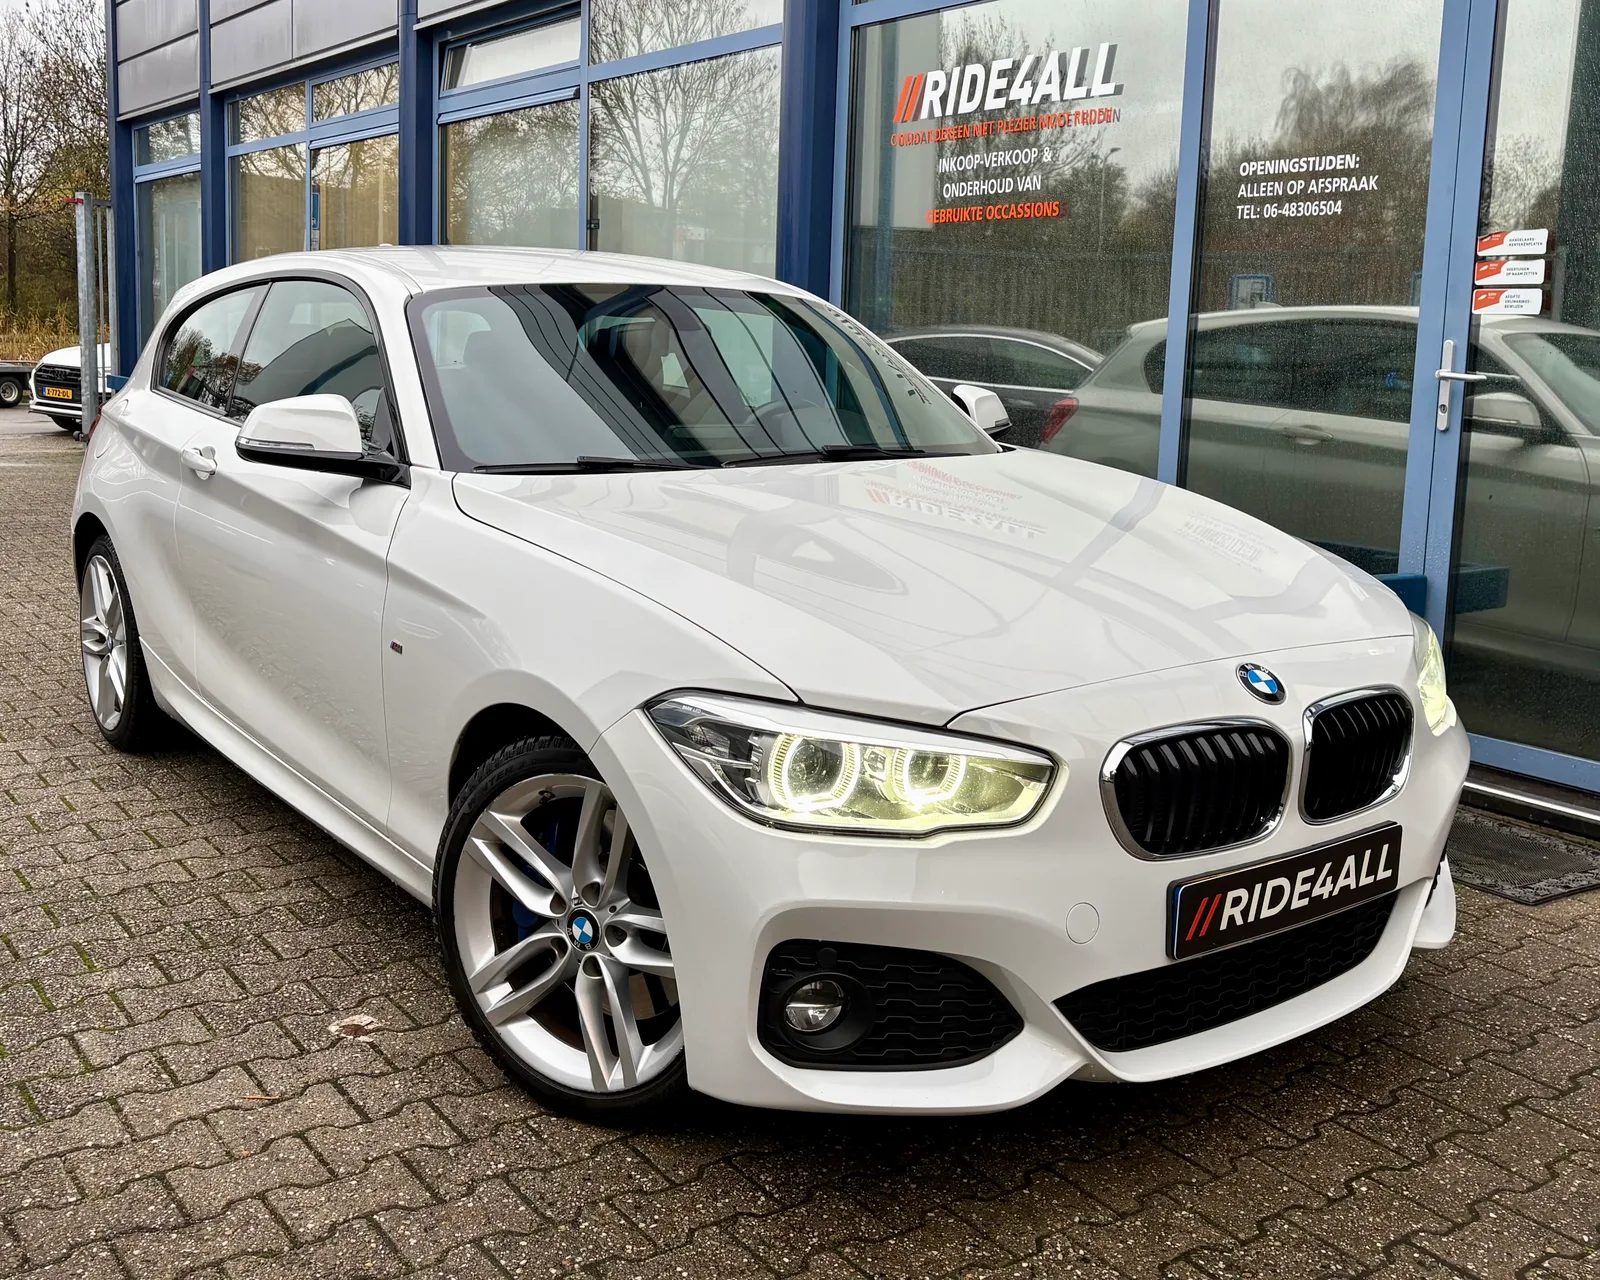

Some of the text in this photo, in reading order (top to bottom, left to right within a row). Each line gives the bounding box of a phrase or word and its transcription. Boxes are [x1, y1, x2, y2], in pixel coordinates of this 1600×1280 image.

[939, 146, 1052, 173] INKOOP-VERKOOP &
[1239, 154, 1360, 176] OPENINGSTIJDEN:
[943, 174, 1041, 199] ONDERHOUD VAN
[1238, 175, 1379, 198] ALLEEN OP AFSPRAAK
[925, 200, 1060, 224] GEBRUIKTE OCCASSIONS
[1237, 200, 1342, 219] TEL: 06-48306504
